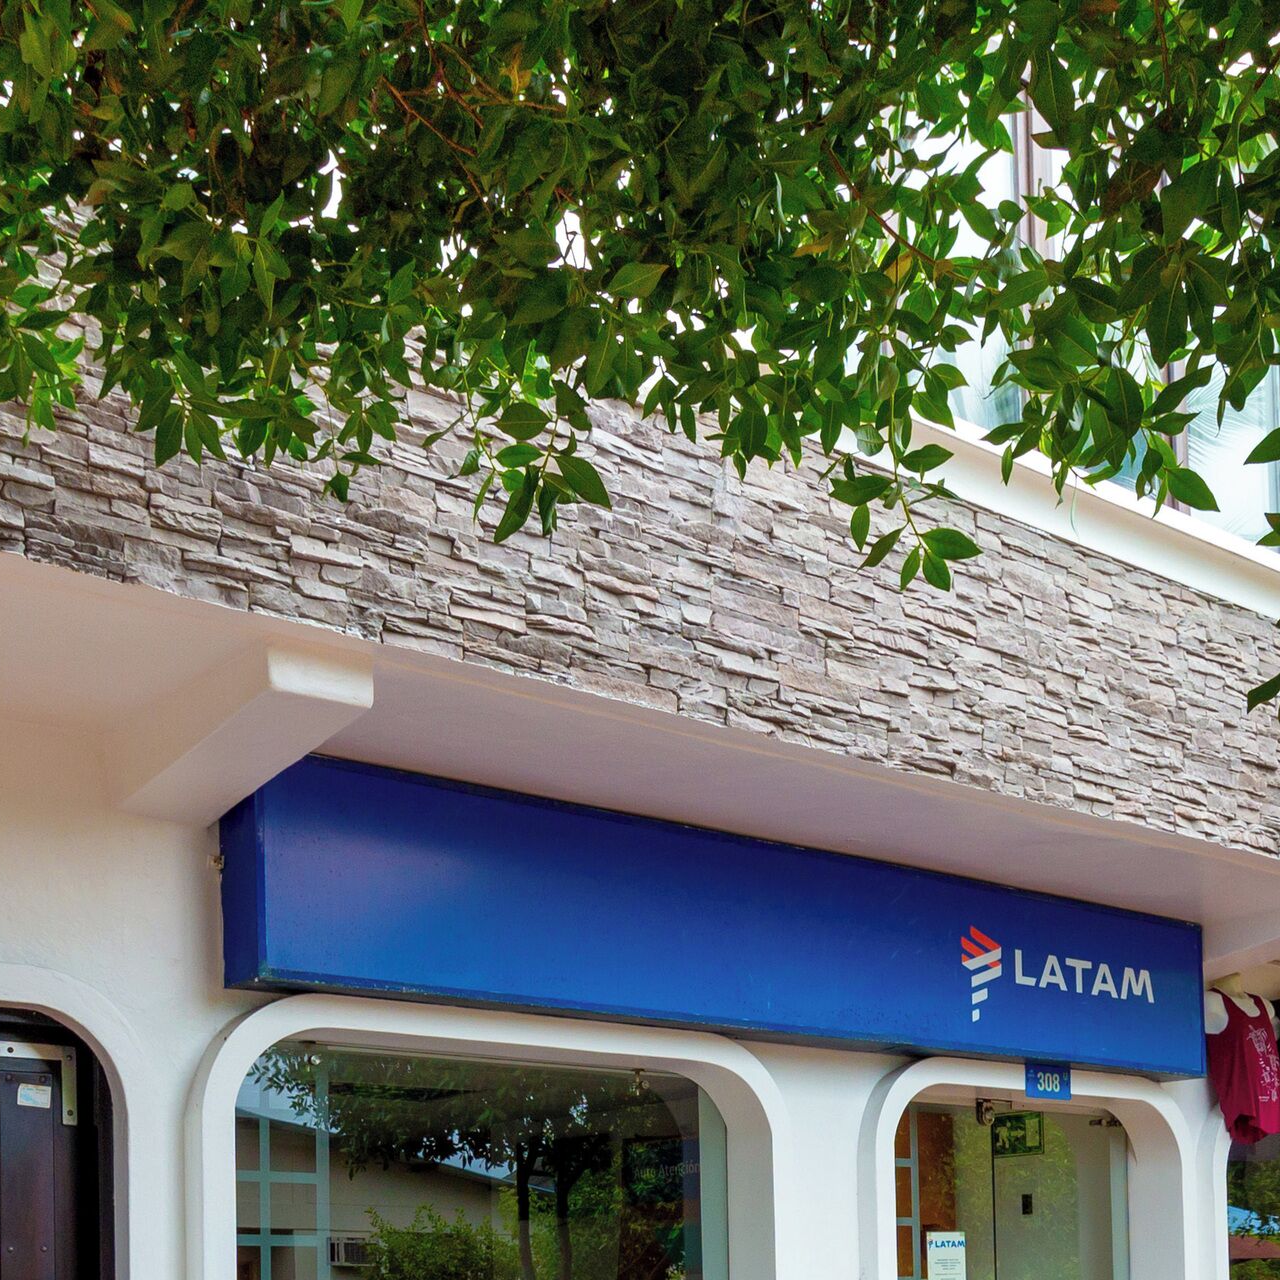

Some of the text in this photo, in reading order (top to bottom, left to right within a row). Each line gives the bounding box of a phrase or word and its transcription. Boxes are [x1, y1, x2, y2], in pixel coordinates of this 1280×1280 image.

[1014, 949, 1155, 1004] LATAM
[1037, 1071, 1060, 1093] 308
[935, 1240, 966, 1249] LATAM
